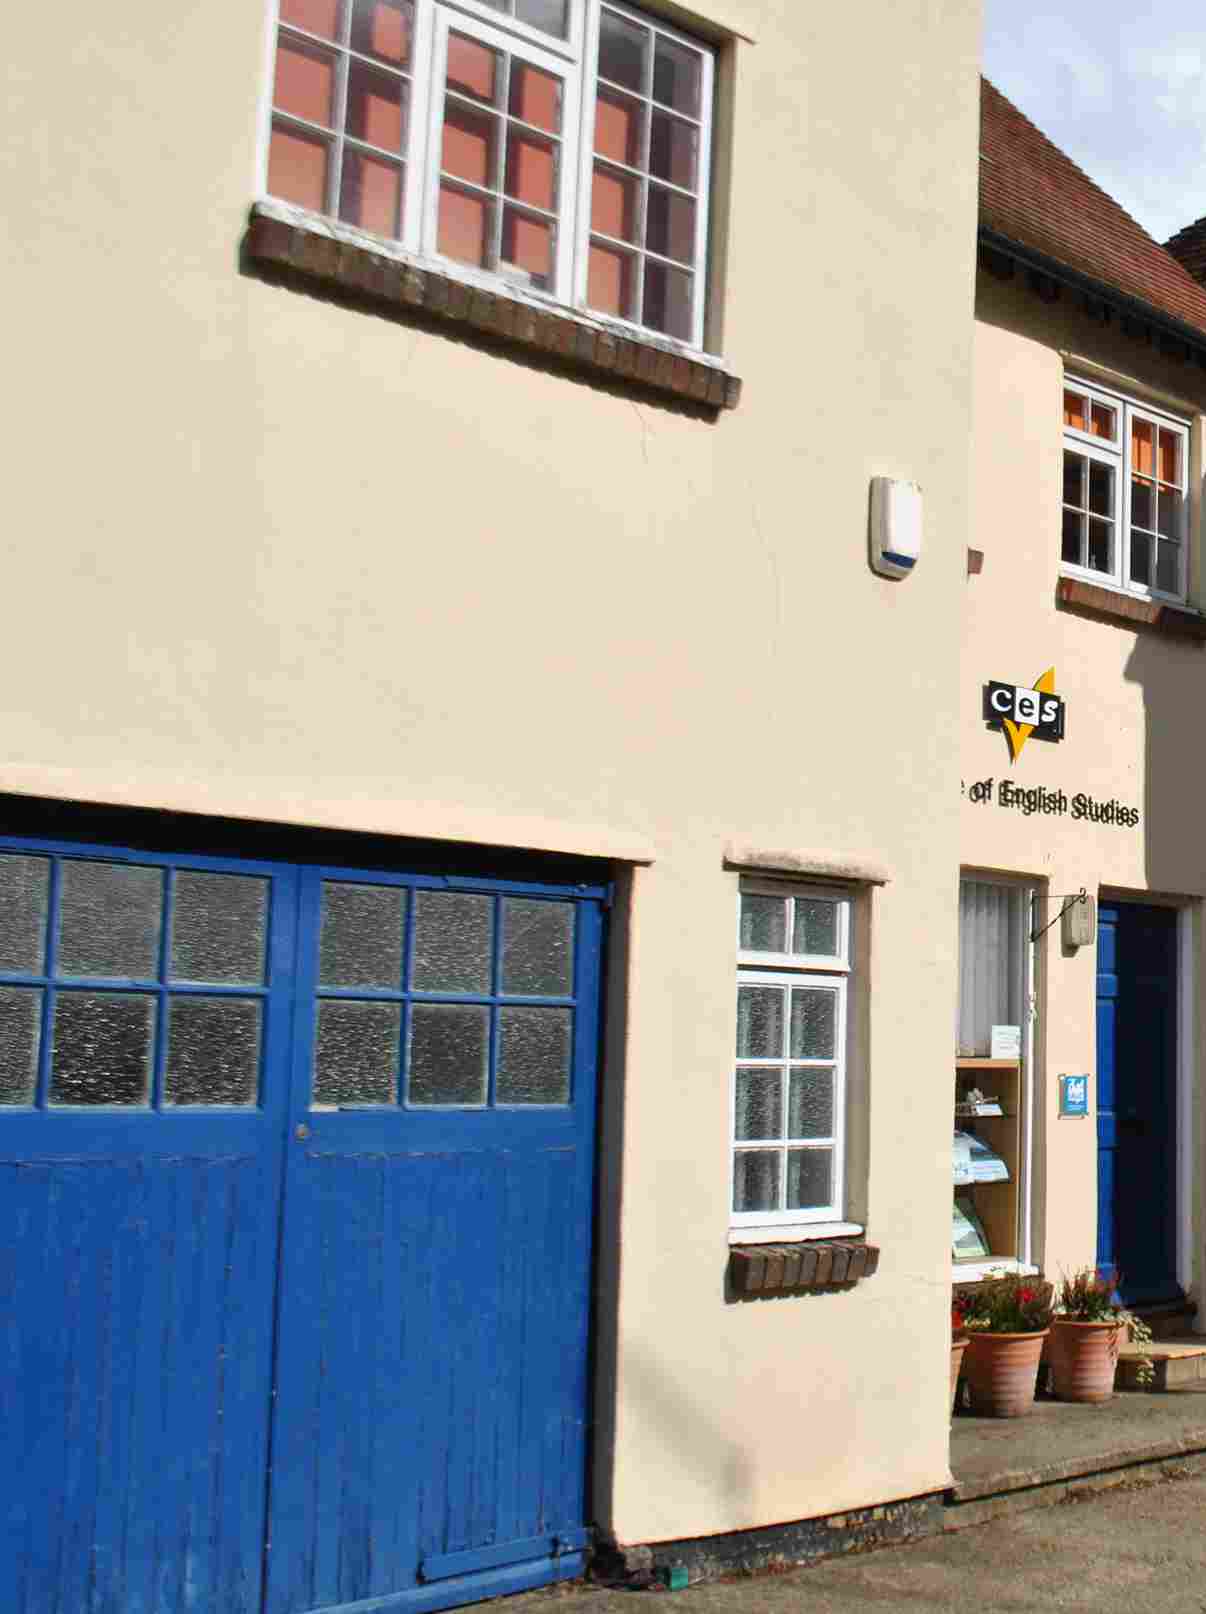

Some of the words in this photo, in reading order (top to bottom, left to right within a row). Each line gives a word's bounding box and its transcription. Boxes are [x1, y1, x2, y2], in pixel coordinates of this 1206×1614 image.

[990, 688, 1059, 723] ces
[970, 777, 994, 803] of
[999, 780, 1067, 815] English
[1072, 793, 1139, 827] Studies
